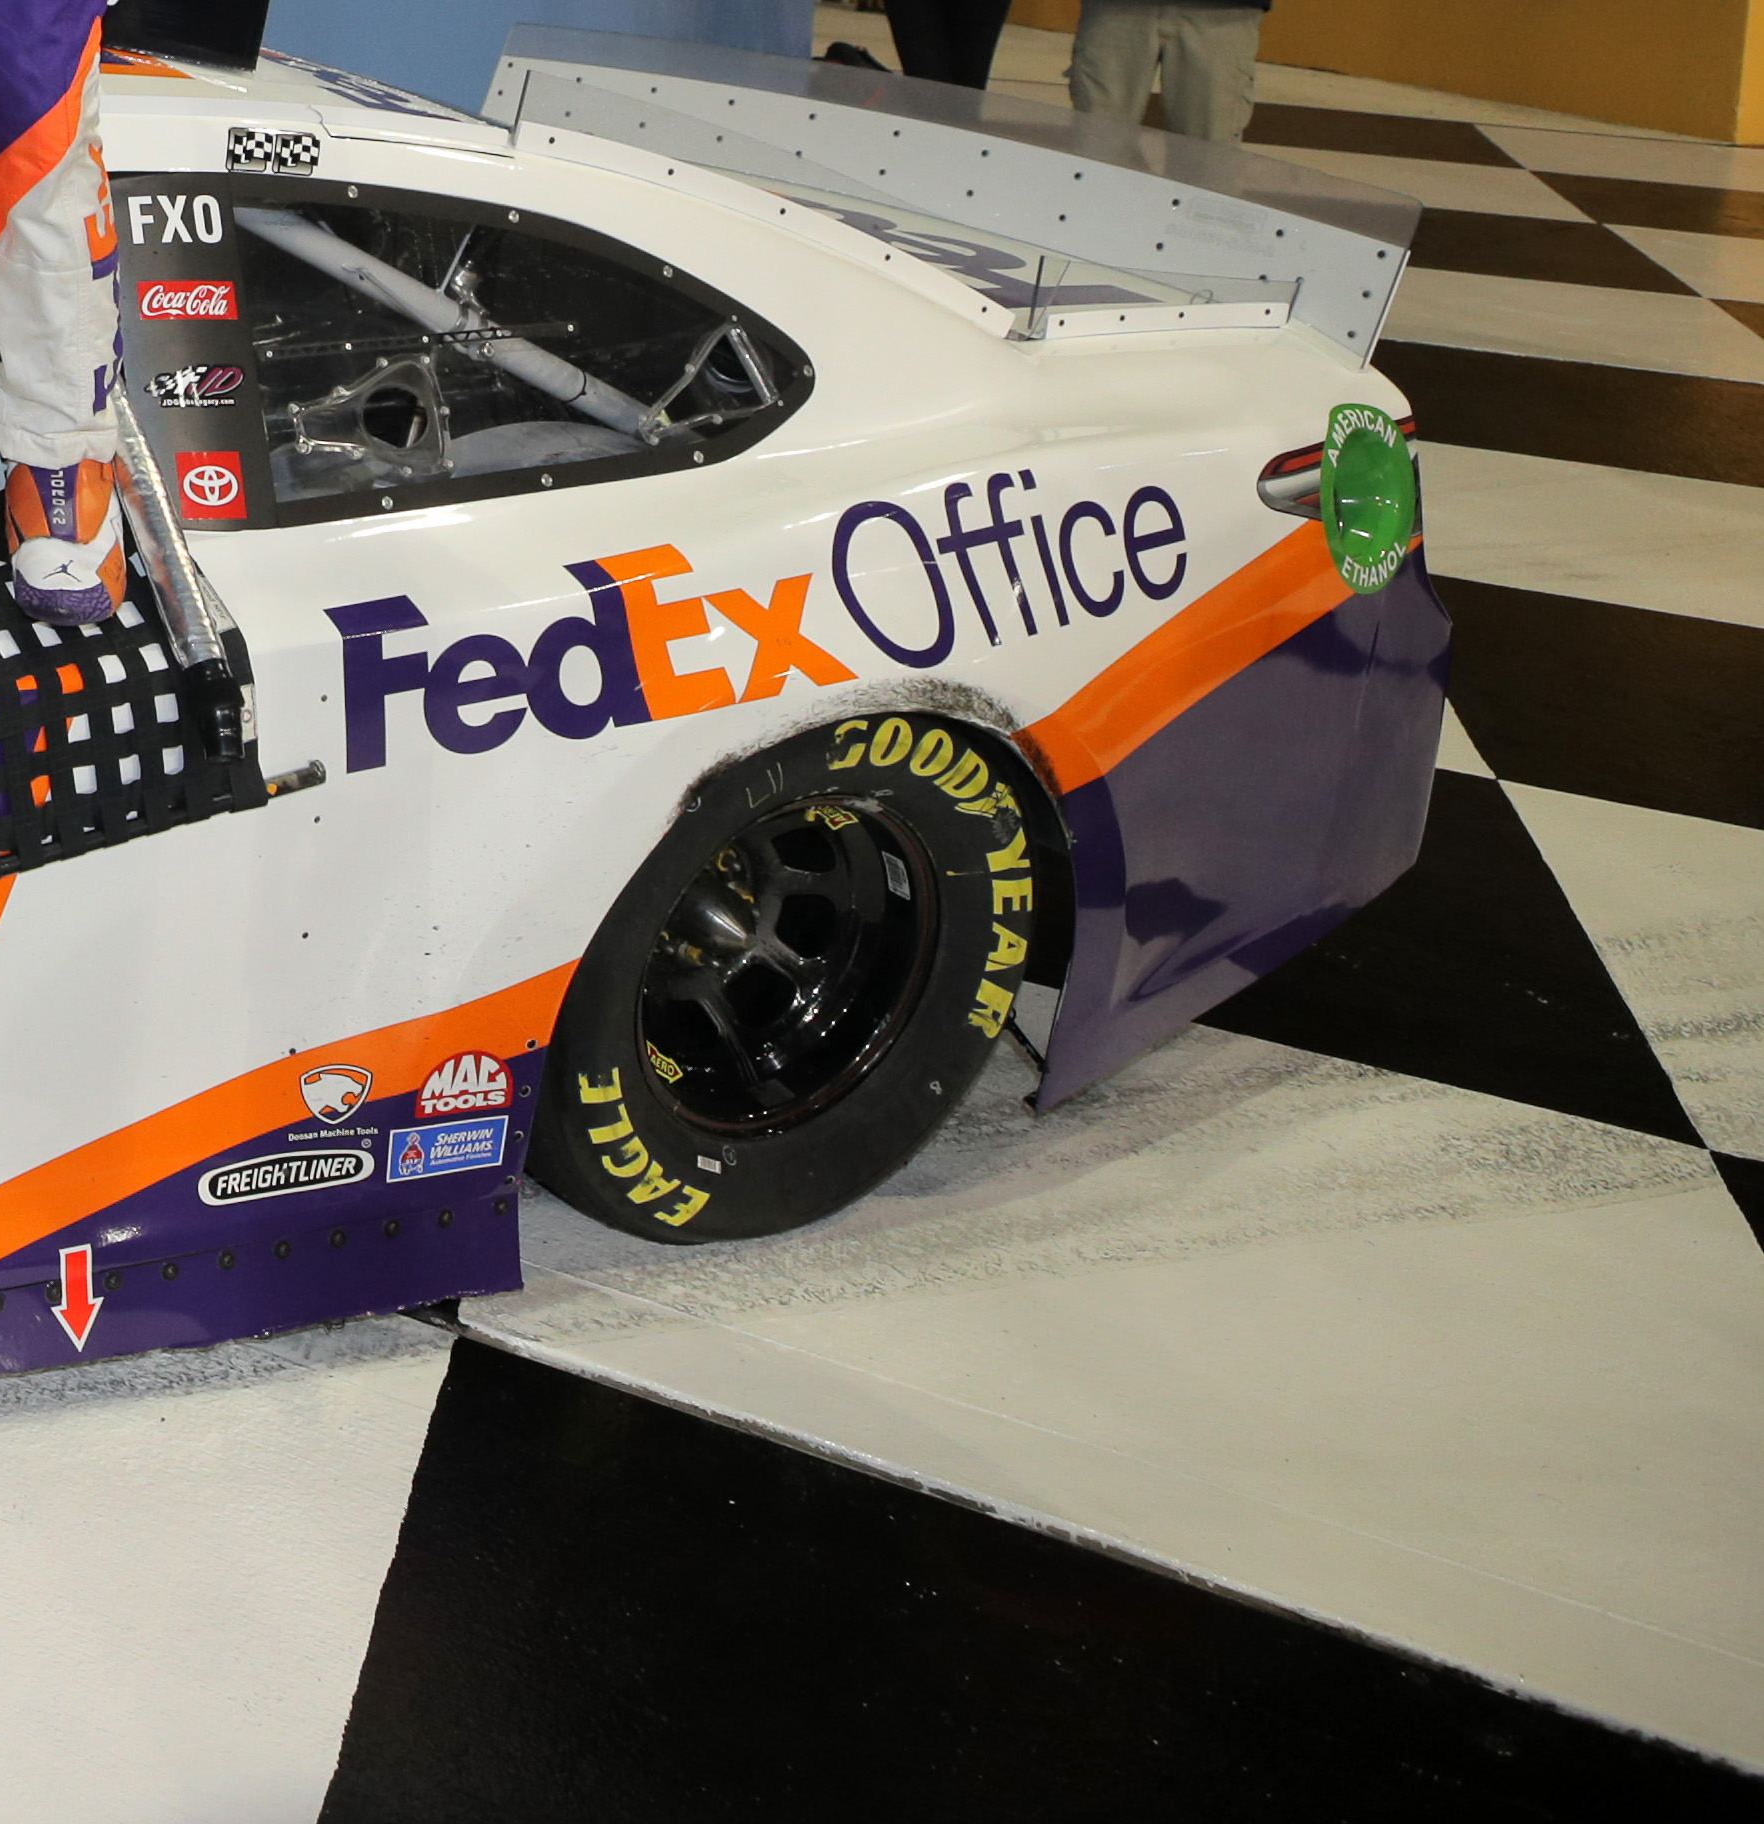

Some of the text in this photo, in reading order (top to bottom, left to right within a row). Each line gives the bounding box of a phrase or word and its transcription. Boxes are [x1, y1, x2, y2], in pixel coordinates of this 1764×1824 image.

[128, 194, 223, 246] FXO
[142, 285, 231, 316] Coca-Cola
[1328, 409, 1397, 468] AMERICAN
[1342, 542, 1406, 587] ETHANOL
[323, 468, 1188, 774] FedEx Office
[422, 1055, 506, 1099] MAC
[651, 1054, 675, 1077] AERO
[423, 1090, 505, 1114] TOOLS
[288, 1127, 378, 1142] Doosan Machine Tools
[430, 1141, 493, 1157] WILLIAMS
[435, 1128, 493, 1146] SHERWIN
[578, 1068, 710, 1227] EAGLE
[216, 1157, 356, 1196] FREIGHTLINER
